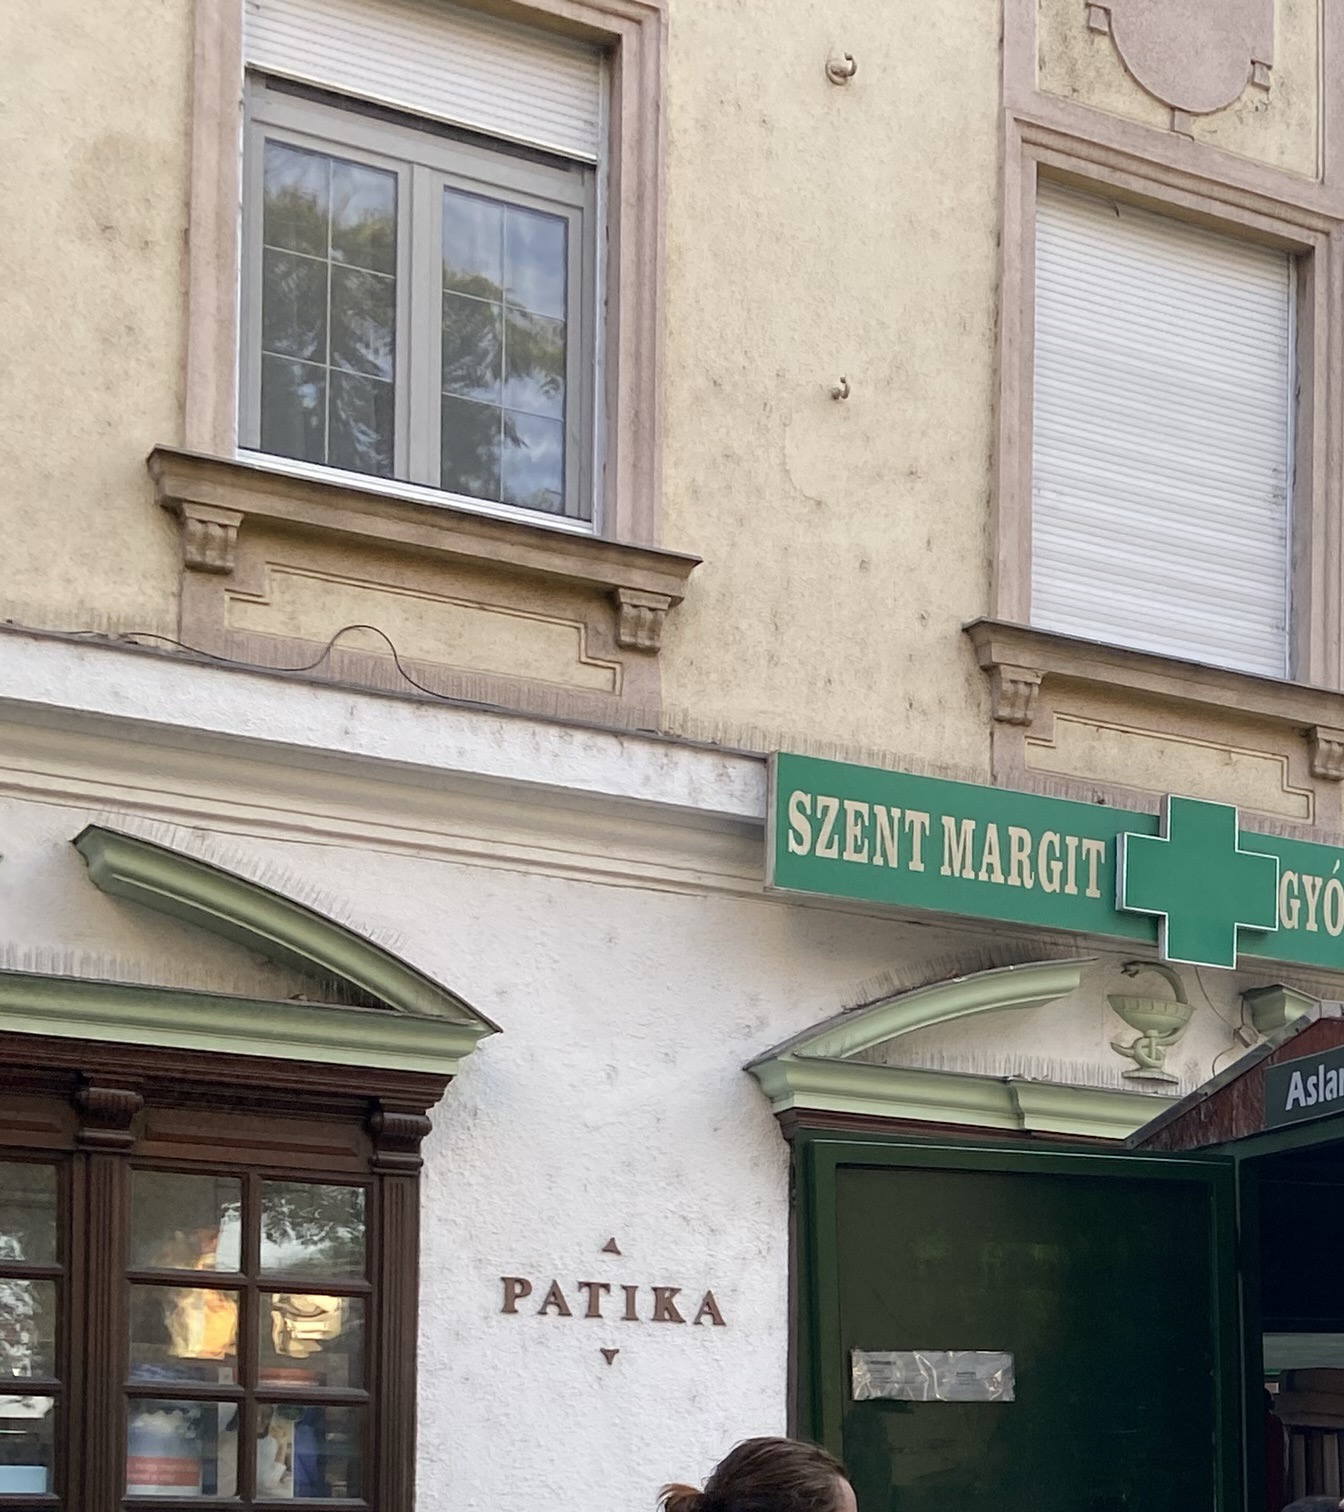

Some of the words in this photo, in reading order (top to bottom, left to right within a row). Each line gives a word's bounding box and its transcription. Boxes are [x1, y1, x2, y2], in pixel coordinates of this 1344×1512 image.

[788, 791, 930, 872] SZENT
[941, 816, 1106, 898] MARGIT
[500, 1276, 727, 1326] PATIKA
